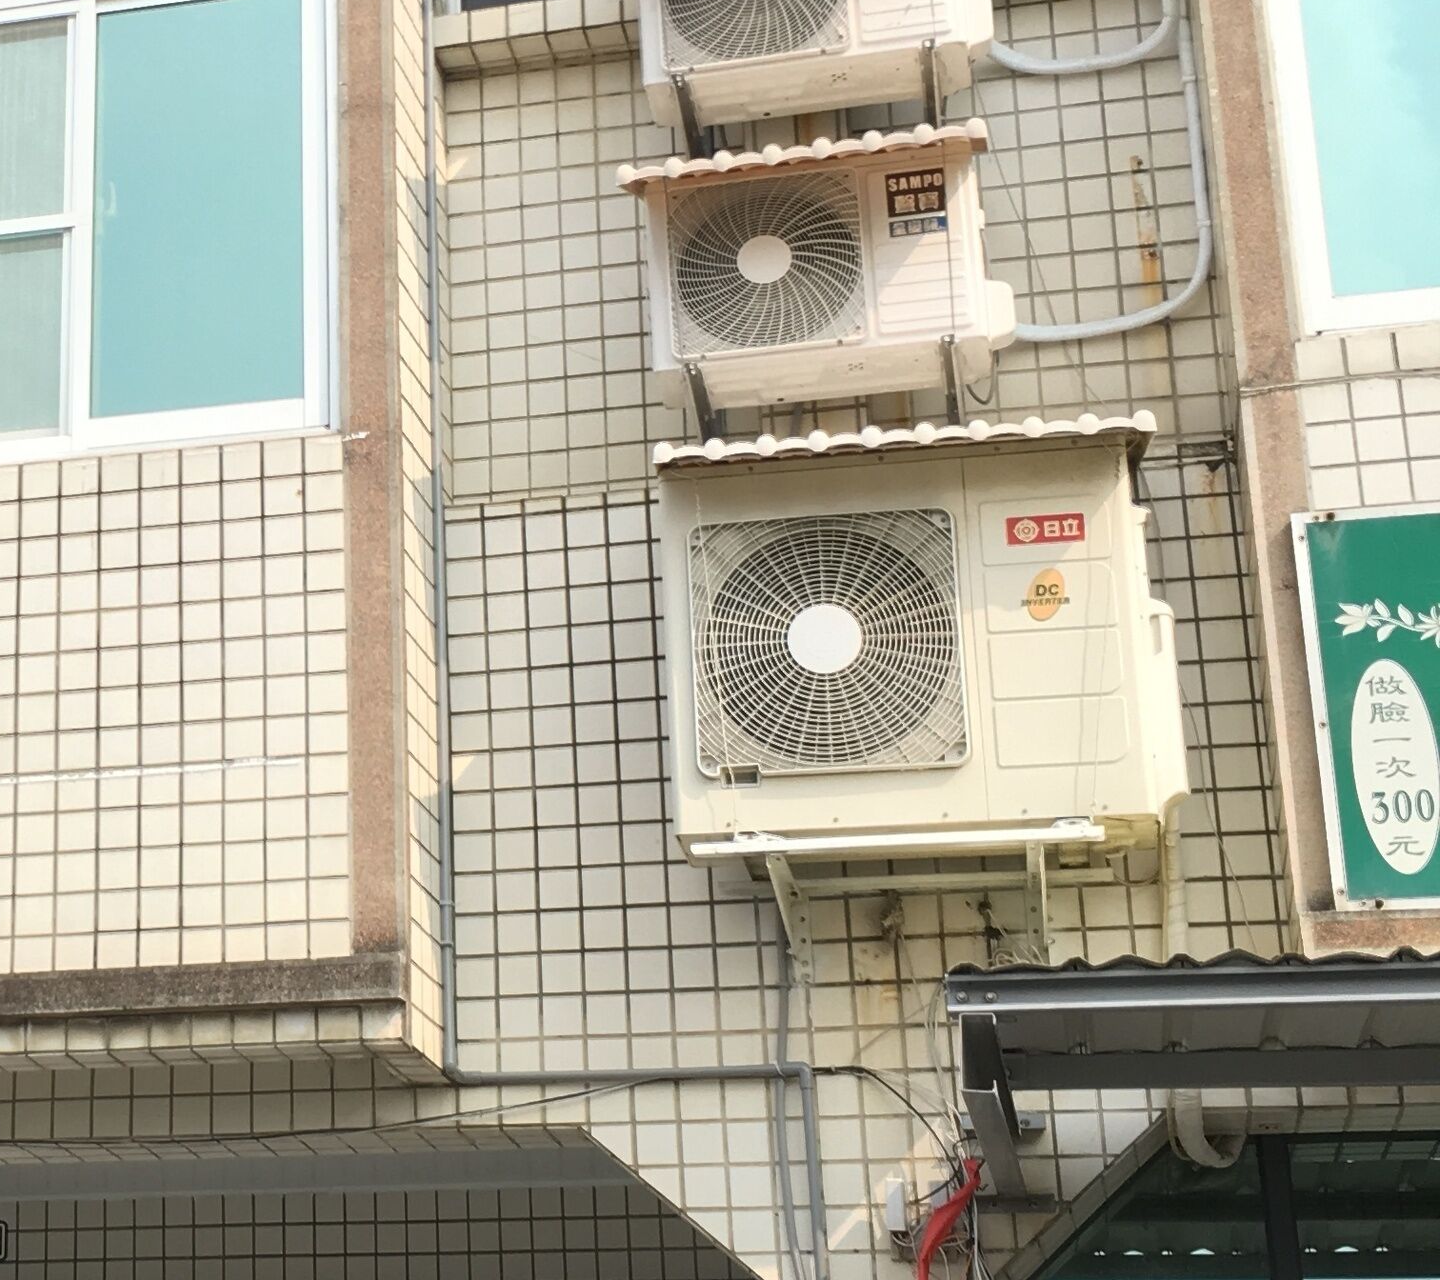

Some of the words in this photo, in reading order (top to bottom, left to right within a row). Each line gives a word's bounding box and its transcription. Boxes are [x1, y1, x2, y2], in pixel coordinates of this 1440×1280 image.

[888, 173, 943, 192] SAMPO
[1043, 518, 1081, 538] 日立
[1035, 584, 1060, 597] DC
